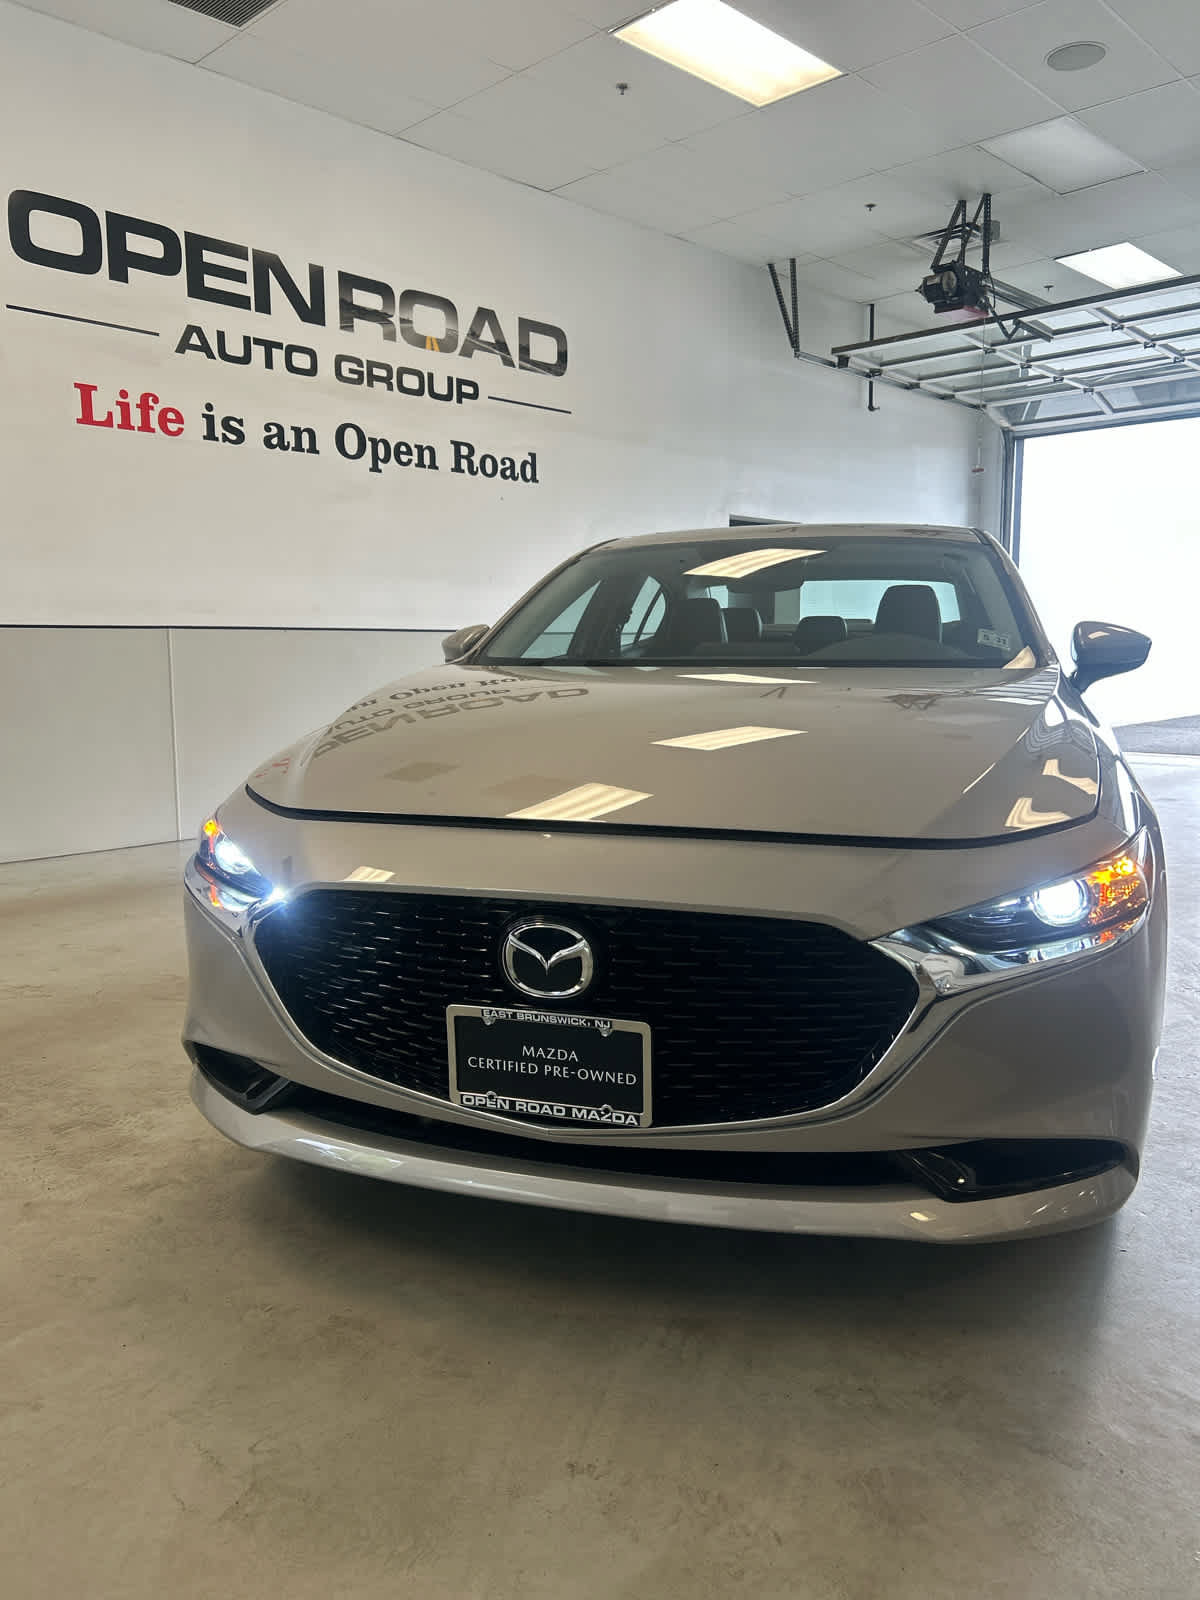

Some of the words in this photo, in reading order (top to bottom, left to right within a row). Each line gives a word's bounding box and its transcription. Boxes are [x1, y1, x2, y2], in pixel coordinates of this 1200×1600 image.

[174, 324, 318, 377] AUTO
[334, 354, 480, 404] GROUP
[73, 382, 185, 437] Life
[201, 403, 245, 445] is
[263, 421, 320, 455] an
[334, 423, 439, 474] Open
[449, 440, 539, 484] Road
[483, 1009, 513, 1019] EAST
[516, 1012, 591, 1027] BRUNSWICK,
[594, 1020, 611, 1029] NJ
[522, 1045, 579, 1063] MAZDA
[467, 1056, 539, 1075] CERTIFIED
[544, 1064, 637, 1085] PRE-OWNED
[462, 1094, 510, 1110] OPEN
[515, 1101, 566, 1117] ROAD
[571, 1108, 638, 1126] MAZDA
